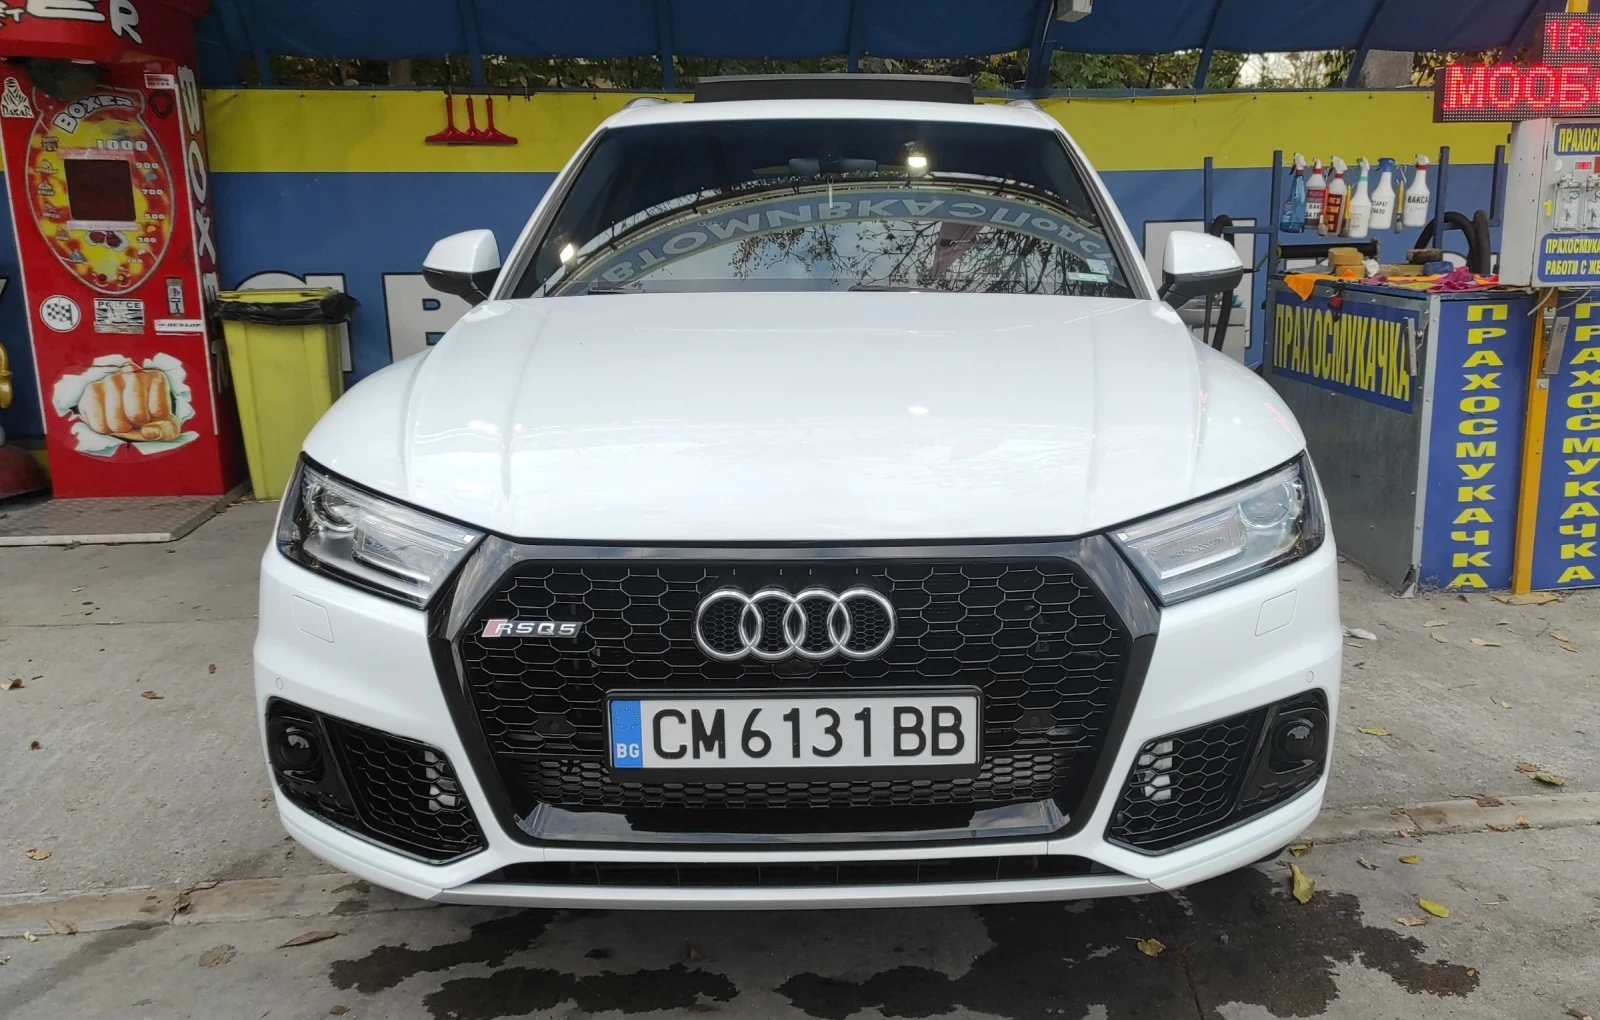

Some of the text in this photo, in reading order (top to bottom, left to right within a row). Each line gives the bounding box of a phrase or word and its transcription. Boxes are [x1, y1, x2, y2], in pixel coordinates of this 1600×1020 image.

[1546, 19, 1600, 53] 16:
[1445, 65, 1600, 110] МООБ
[1, 104, 33, 117] DAKAR
[53, 95, 134, 134] BOXER
[96, 139, 147, 151] 1000
[1544, 199, 1552, 216] 1
[1545, 260, 1579, 276] РАБОТИ
[1273, 303, 1410, 402] ПРАХОСМУКАЧКА
[1448, 303, 1508, 588] ПРАХОСМУКАЧКА
[494, 622, 577, 636] RSQ5
[740, 707, 873, 759] 6131
[616, 743, 640, 760] BG
